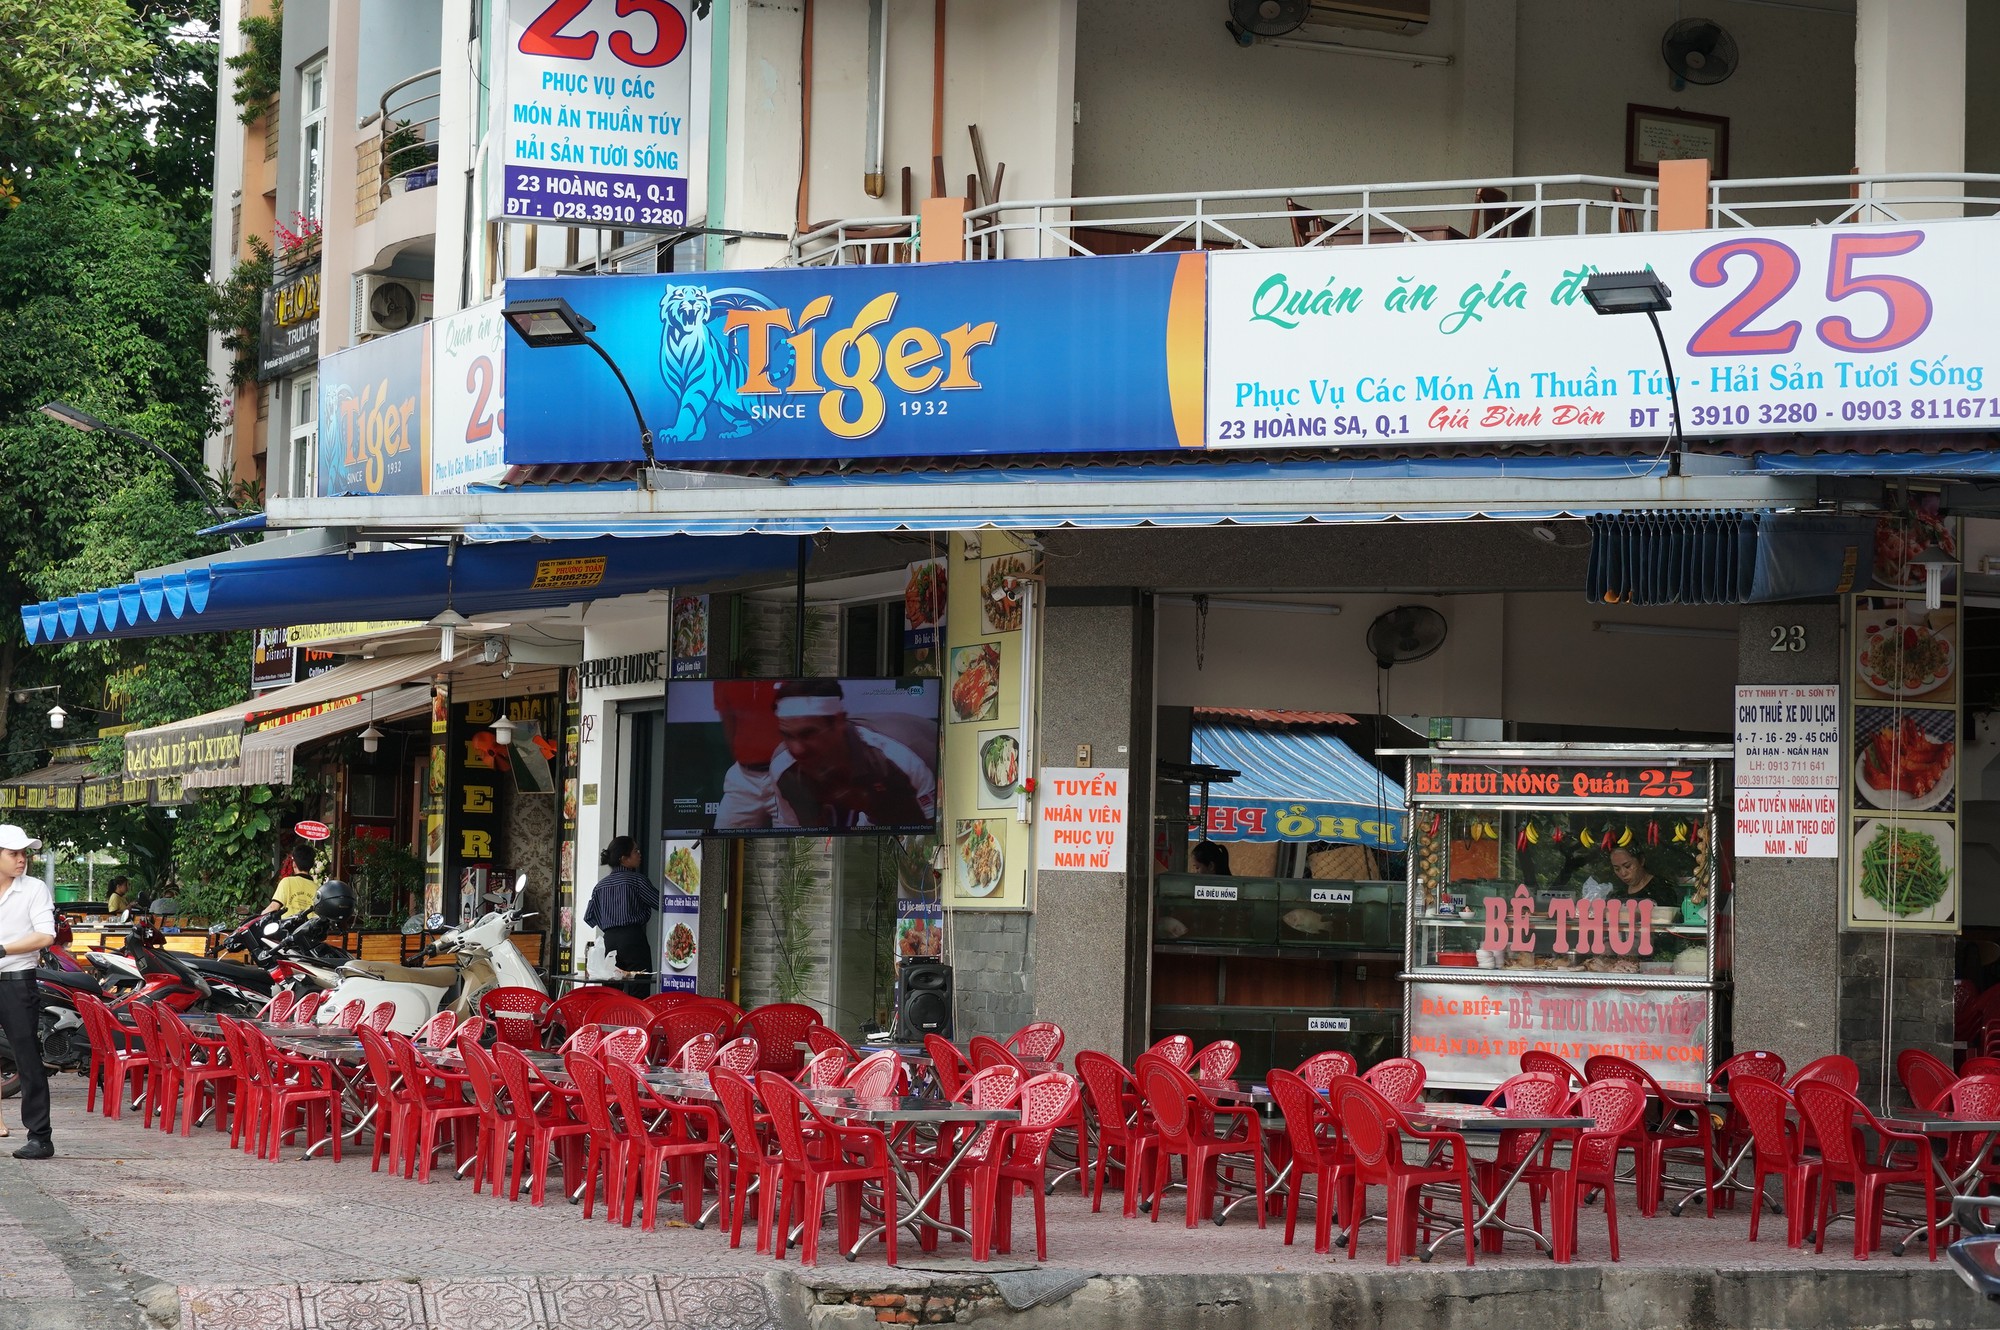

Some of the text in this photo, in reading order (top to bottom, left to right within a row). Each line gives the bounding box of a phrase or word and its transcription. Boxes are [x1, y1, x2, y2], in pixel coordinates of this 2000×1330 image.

[518, 0, 687, 68] 25
[542, 71, 655, 99] PHỤC VỤ CÁC
[513, 101, 681, 135] MÓN ĂN THUẦN TÚY
[516, 133, 678, 170] HẢI SẢN TƯƠI SỐNG
[517, 175, 675, 202] 23 HOÀNG SA, Q.1
[507, 198, 530, 215] ĐT
[640, 209, 683, 225] 3280
[1249, 272, 1363, 329] Quán
[1384, 275, 1438, 313] ăn
[1687, 230, 1933, 357] 25
[287, 323, 309, 346] TRULY
[445, 317, 473, 358] Quán
[478, 315, 492, 340] ăn
[723, 292, 998, 439] Tiger
[1235, 355, 1984, 411] Phục Vụ Các Món Ăn Thuần Túy Hải Sản Tươi Sống
[751, 401, 949, 419] SINCE 1932
[1428, 404, 1606, 430] Giá Bình Dân
[1629, 407, 1660, 428] ĐT
[1690, 404, 1750, 426] 3910
[1758, 402, 1818, 425] 3280
[1841, 400, 1902, 422] 0903
[340, 377, 415, 494] Tiger
[1218, 413, 1409, 440] 23 HOÀNG SA, Q.1
[347, 460, 402, 485] SINCE 1932
[1770, 625, 1807, 651] 23
[266, 649, 287, 662] DISTRICT
[579, 650, 668, 689] PEPPER HOUSE
[1739, 688, 1824, 698] CTY TNHH VT SƠN
[1739, 700, 1836, 727] CHO THUÊ XE DU LỊCH
[1737, 727, 1838, 743] 4 7 16 29 45 CHỖ
[127, 730, 241, 777] ĐẶC SẢN DÊ XUYÊN
[1746, 746, 1829, 757] DÀI HẠN NGẮN HẠN
[1749, 761, 1825, 771] LH: 0913 711 641
[1053, 772, 1117, 796] TUYỂN
[1416, 767, 1694, 797] BÊ THUI NÓNG Quán 25
[1792, 775, 1809, 786] 0903
[1810, 775, 1821, 786] 811
[1822, 775, 1838, 786] 671
[1044, 804, 1121, 823] NHÂN VIÊN
[1738, 790, 1835, 813] CẦN TUYỂN NHÂN VIÊN
[1737, 814, 1836, 838] PHỤC VỤ LÀM THEO GIỜ
[1054, 830, 1114, 849] PHỤC VỤ
[1765, 834, 1809, 854] NAM NỮ
[1055, 849, 1111, 868] NAM NỮ
[1196, 888, 1204, 897] CÁ
[1313, 892, 1326, 900] CÁ
[899, 901, 906, 911] Cá
[1482, 884, 1653, 956] BÊ THUI
[1311, 1020, 1318, 1028] CÁ
[1422, 997, 1458, 1018] ĐẶC
[1463, 995, 1502, 1020] BIỆT
[1508, 991, 1533, 1030] BÊ
[1539, 998, 1588, 1032] THUI
[1592, 998, 1652, 1034] MANG
[1411, 1034, 1704, 1062] NHẬN ĐẶT BÊ QUAY NGUYÊN CON
